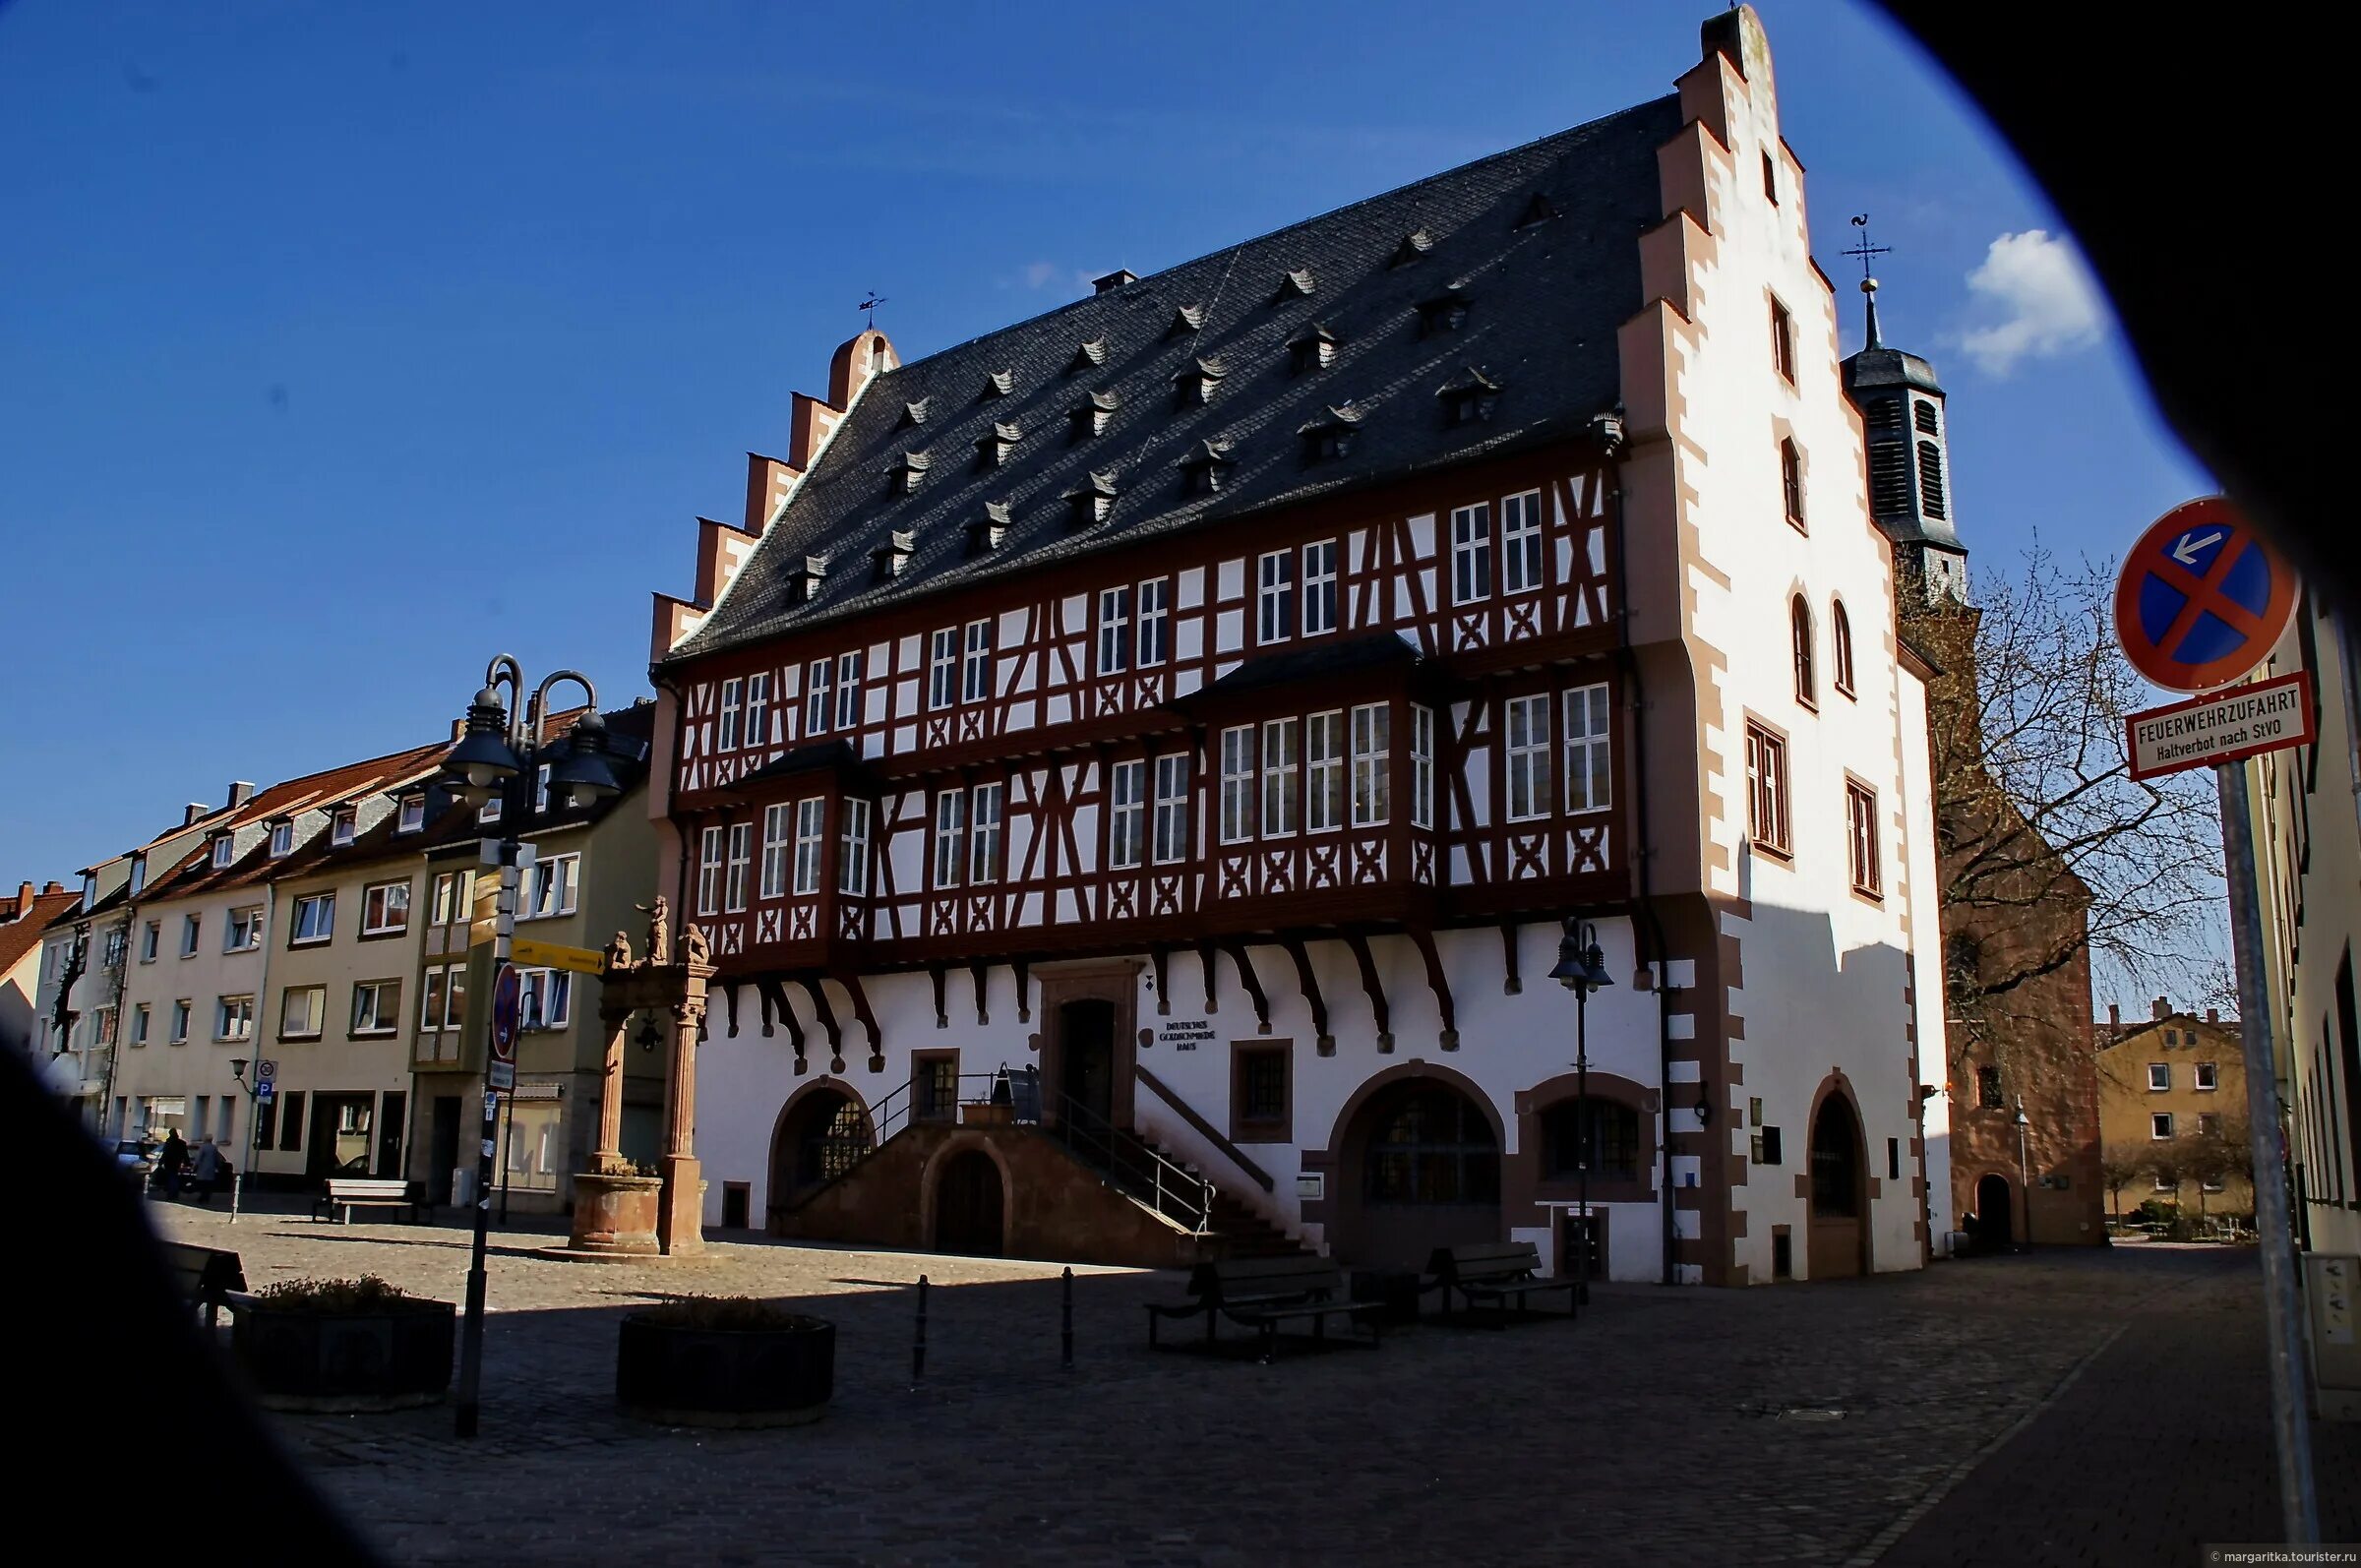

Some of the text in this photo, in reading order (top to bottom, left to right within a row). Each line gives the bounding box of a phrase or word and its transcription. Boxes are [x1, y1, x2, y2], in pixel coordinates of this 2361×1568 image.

[2139, 690, 2297, 744] FEUERWEHRZUFAHRT
[2157, 719, 2281, 761] Haltverbot nach StVO
[1166, 1021, 1208, 1031] DEUTSCHES
[260, 1083, 270, 1096] P
